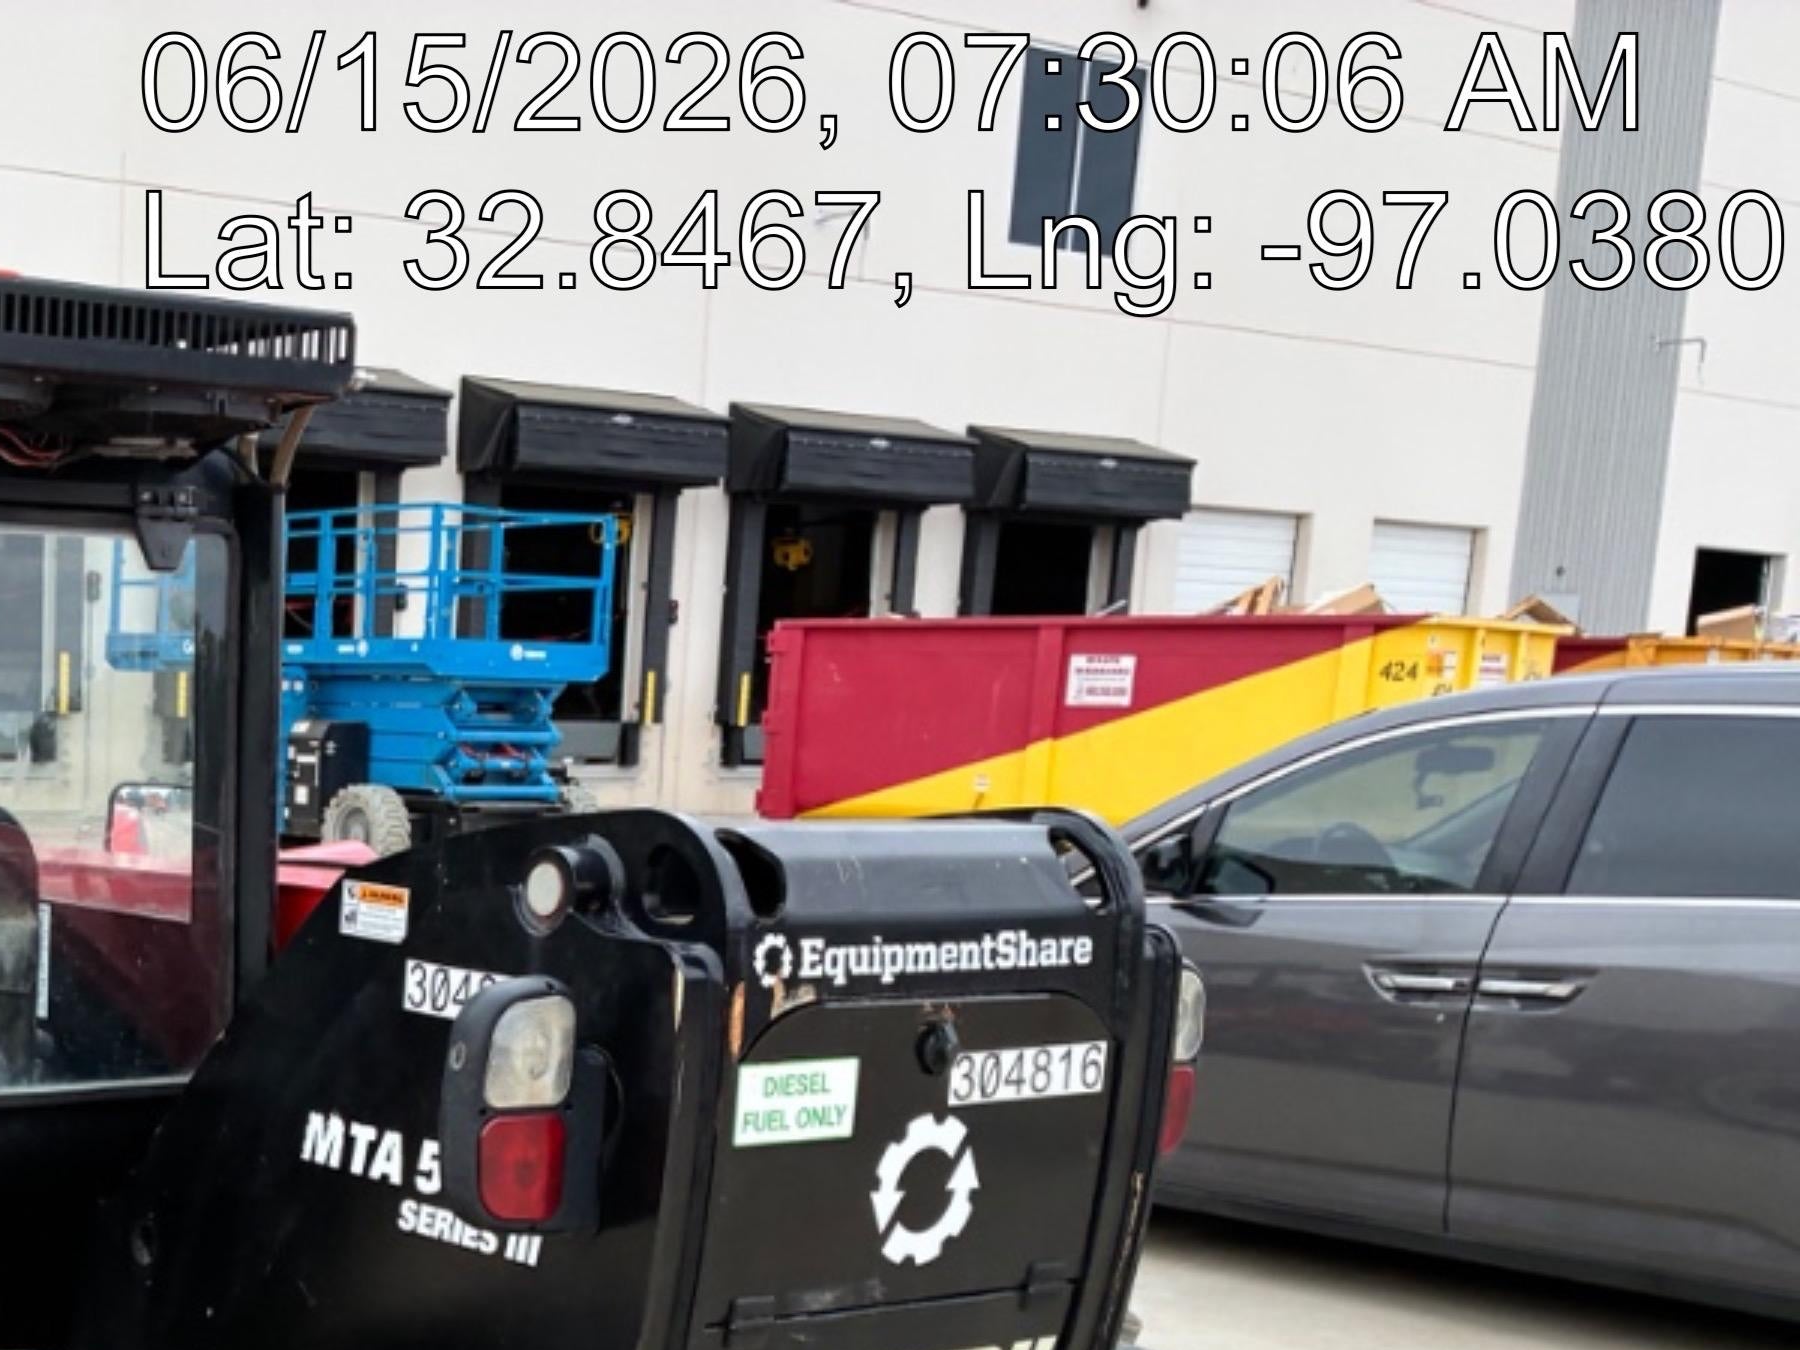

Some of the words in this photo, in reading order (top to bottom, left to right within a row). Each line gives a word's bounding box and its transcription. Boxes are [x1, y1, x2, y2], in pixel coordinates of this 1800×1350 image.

[1379, 659, 1419, 682] 424
[798, 929, 1093, 987] EquipmentShare
[763, 1071, 831, 1098] DIESEL
[953, 1043, 1103, 1101] 304816
[741, 1109, 790, 1134] FUEL
[798, 1104, 848, 1130] ONLY
[300, 1110, 404, 1187] MTA
[397, 1199, 499, 1256] SERIES
